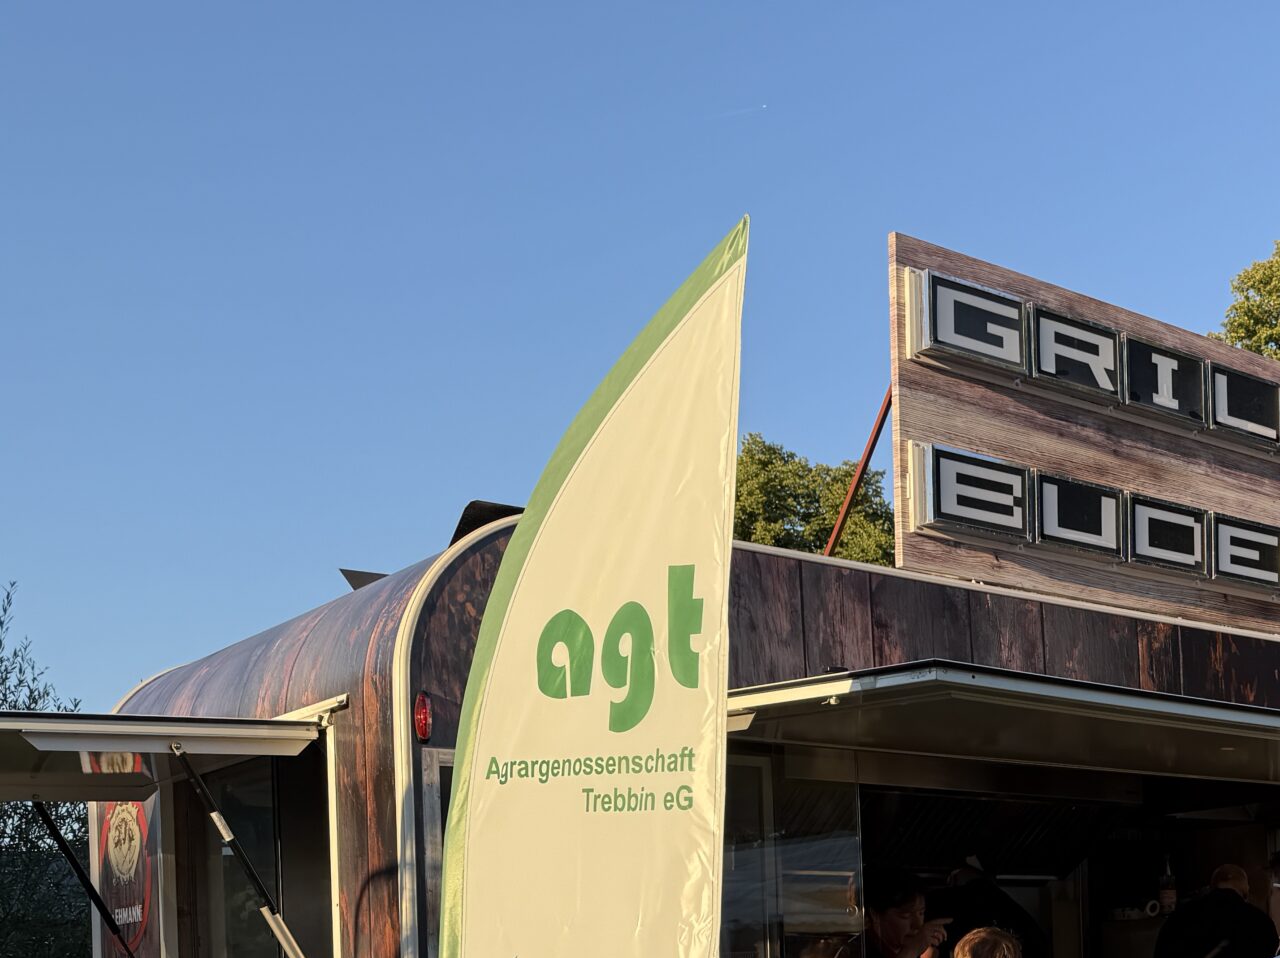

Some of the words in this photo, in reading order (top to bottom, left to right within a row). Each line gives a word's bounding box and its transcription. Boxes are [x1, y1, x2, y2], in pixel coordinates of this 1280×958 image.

[939, 456, 1279, 583] BUDE
[536, 564, 704, 733] agt
[485, 746, 695, 785] Agrargenossenschaft
[582, 786, 655, 813] Trebbin
[663, 785, 694, 811] eG
[112, 904, 143, 926] EHMANN
